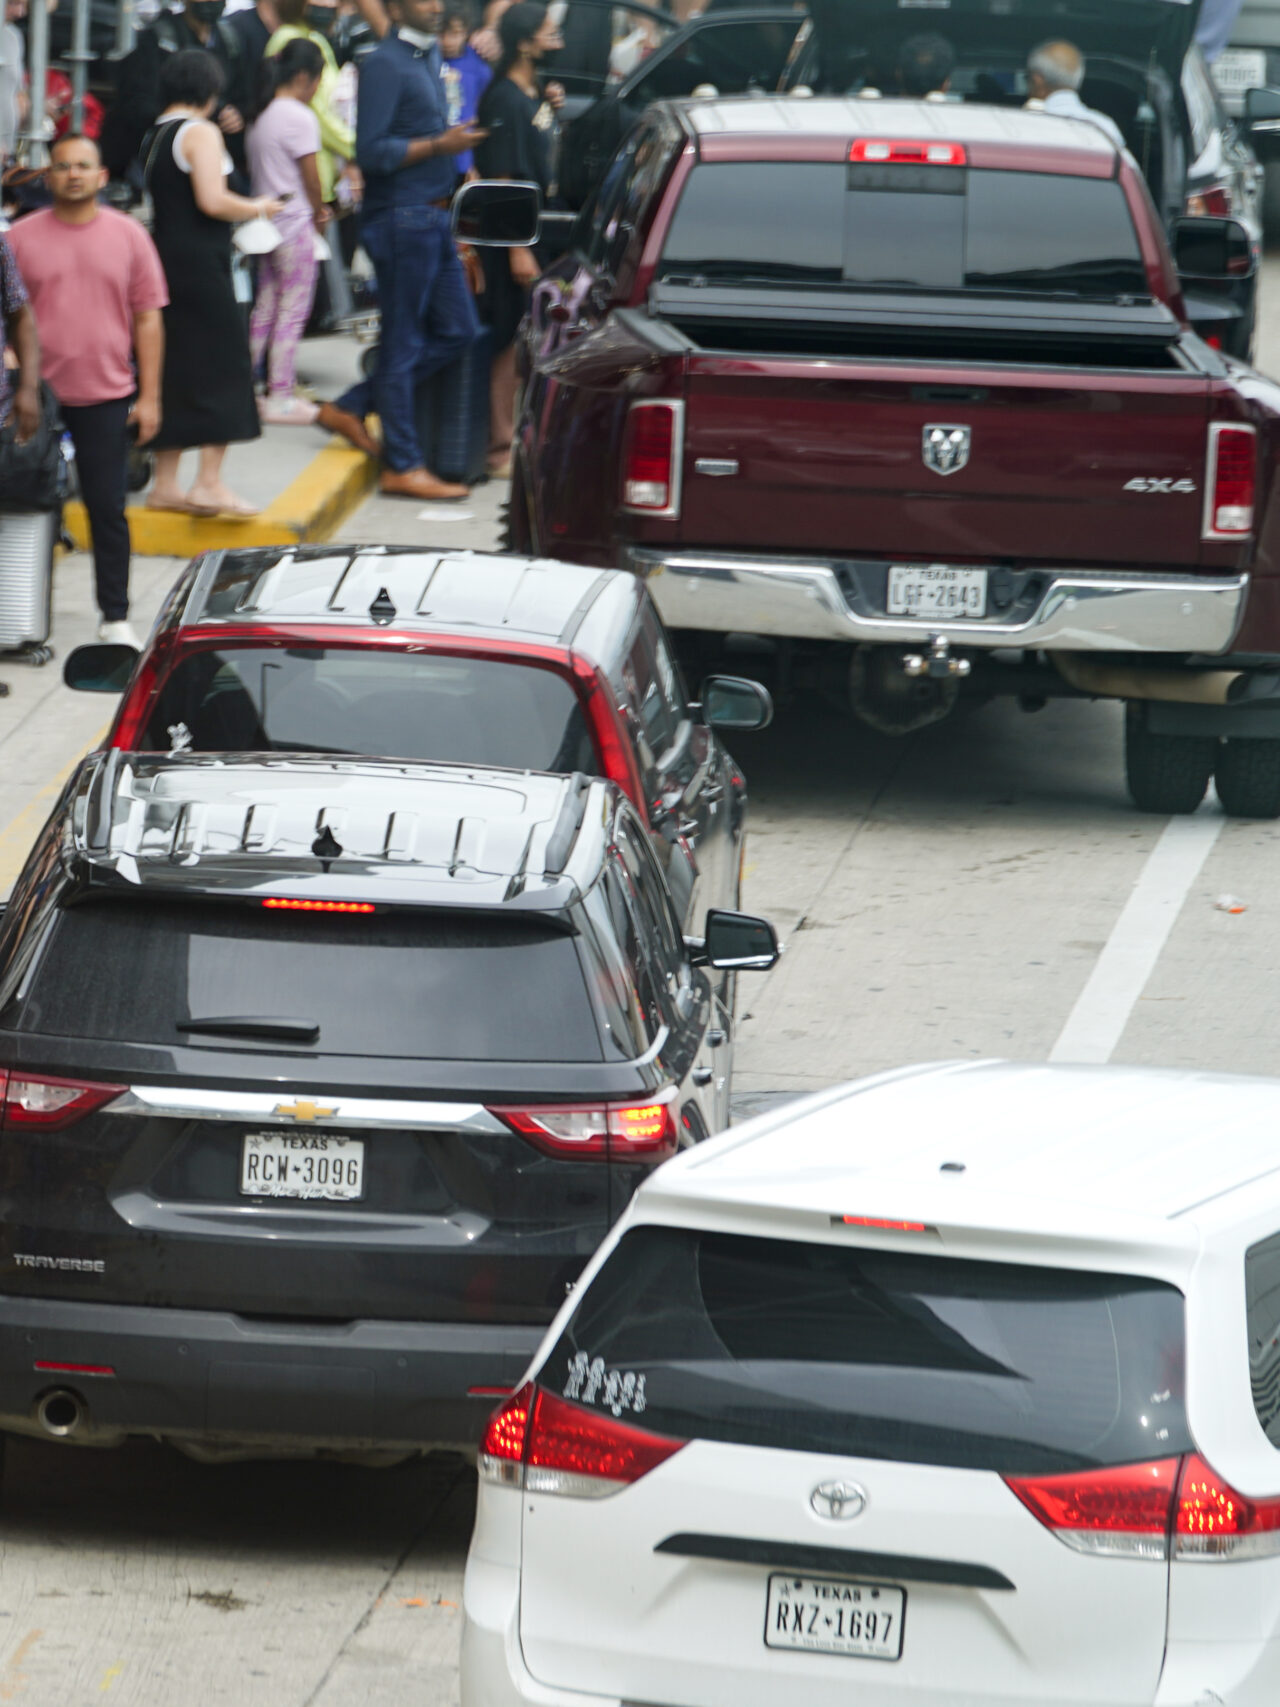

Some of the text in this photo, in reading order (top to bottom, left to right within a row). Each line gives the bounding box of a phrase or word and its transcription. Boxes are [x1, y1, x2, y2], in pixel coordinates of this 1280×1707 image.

[281, 1138, 329, 1151] TEXAS
[13, 1253, 106, 1272] TRAVERSE
[813, 1582, 862, 1601] TEXAS
